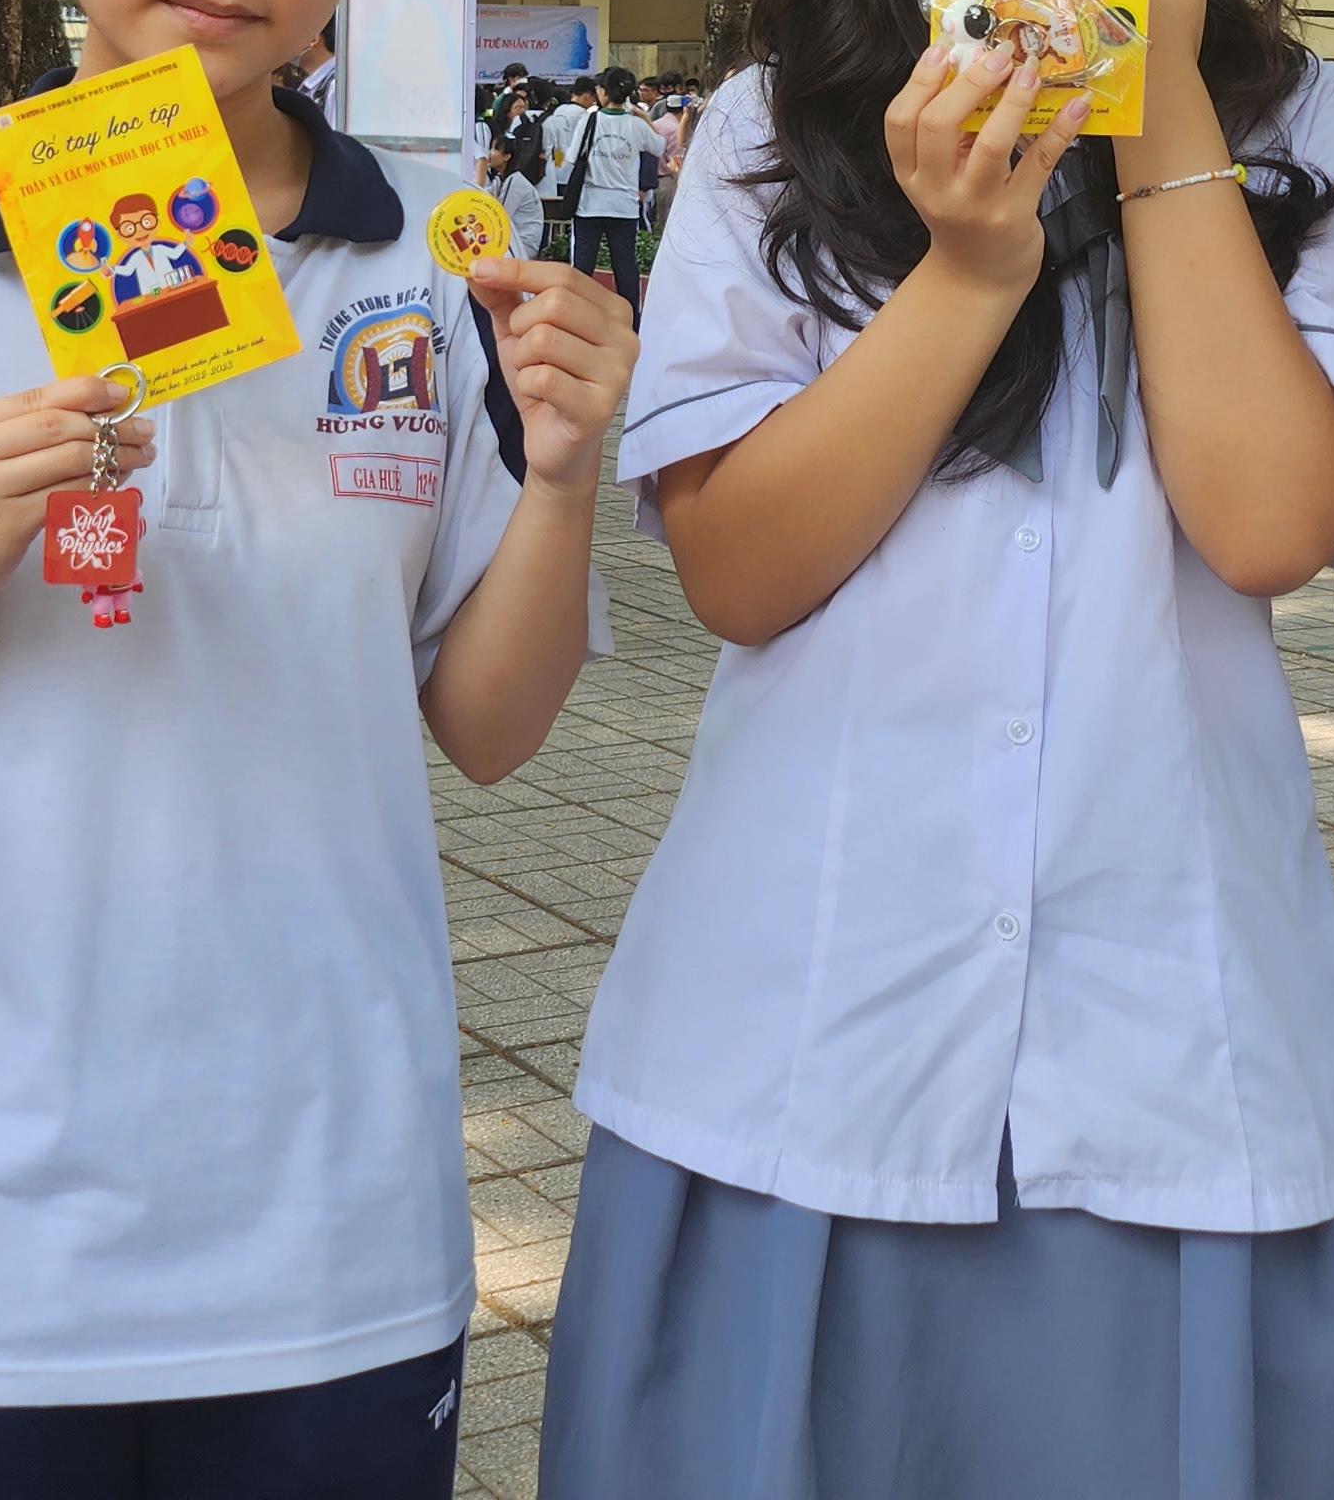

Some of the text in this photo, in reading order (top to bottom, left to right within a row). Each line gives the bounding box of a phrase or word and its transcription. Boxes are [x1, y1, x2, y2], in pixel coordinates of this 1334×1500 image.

[67, 131, 101, 155] tay
[107, 116, 143, 138] học
[150, 103, 180, 128] tập
[109, 149, 139, 166] KHOA
[319, 308, 352, 352] TRƯỜNG
[350, 293, 392, 314] TRUNG
[396, 287, 417, 307] HỌC
[316, 414, 386, 433] HÙNG
[353, 467, 376, 489] GIA
[379, 464, 403, 497] HUỆ
[59, 534, 126, 560] Physics
